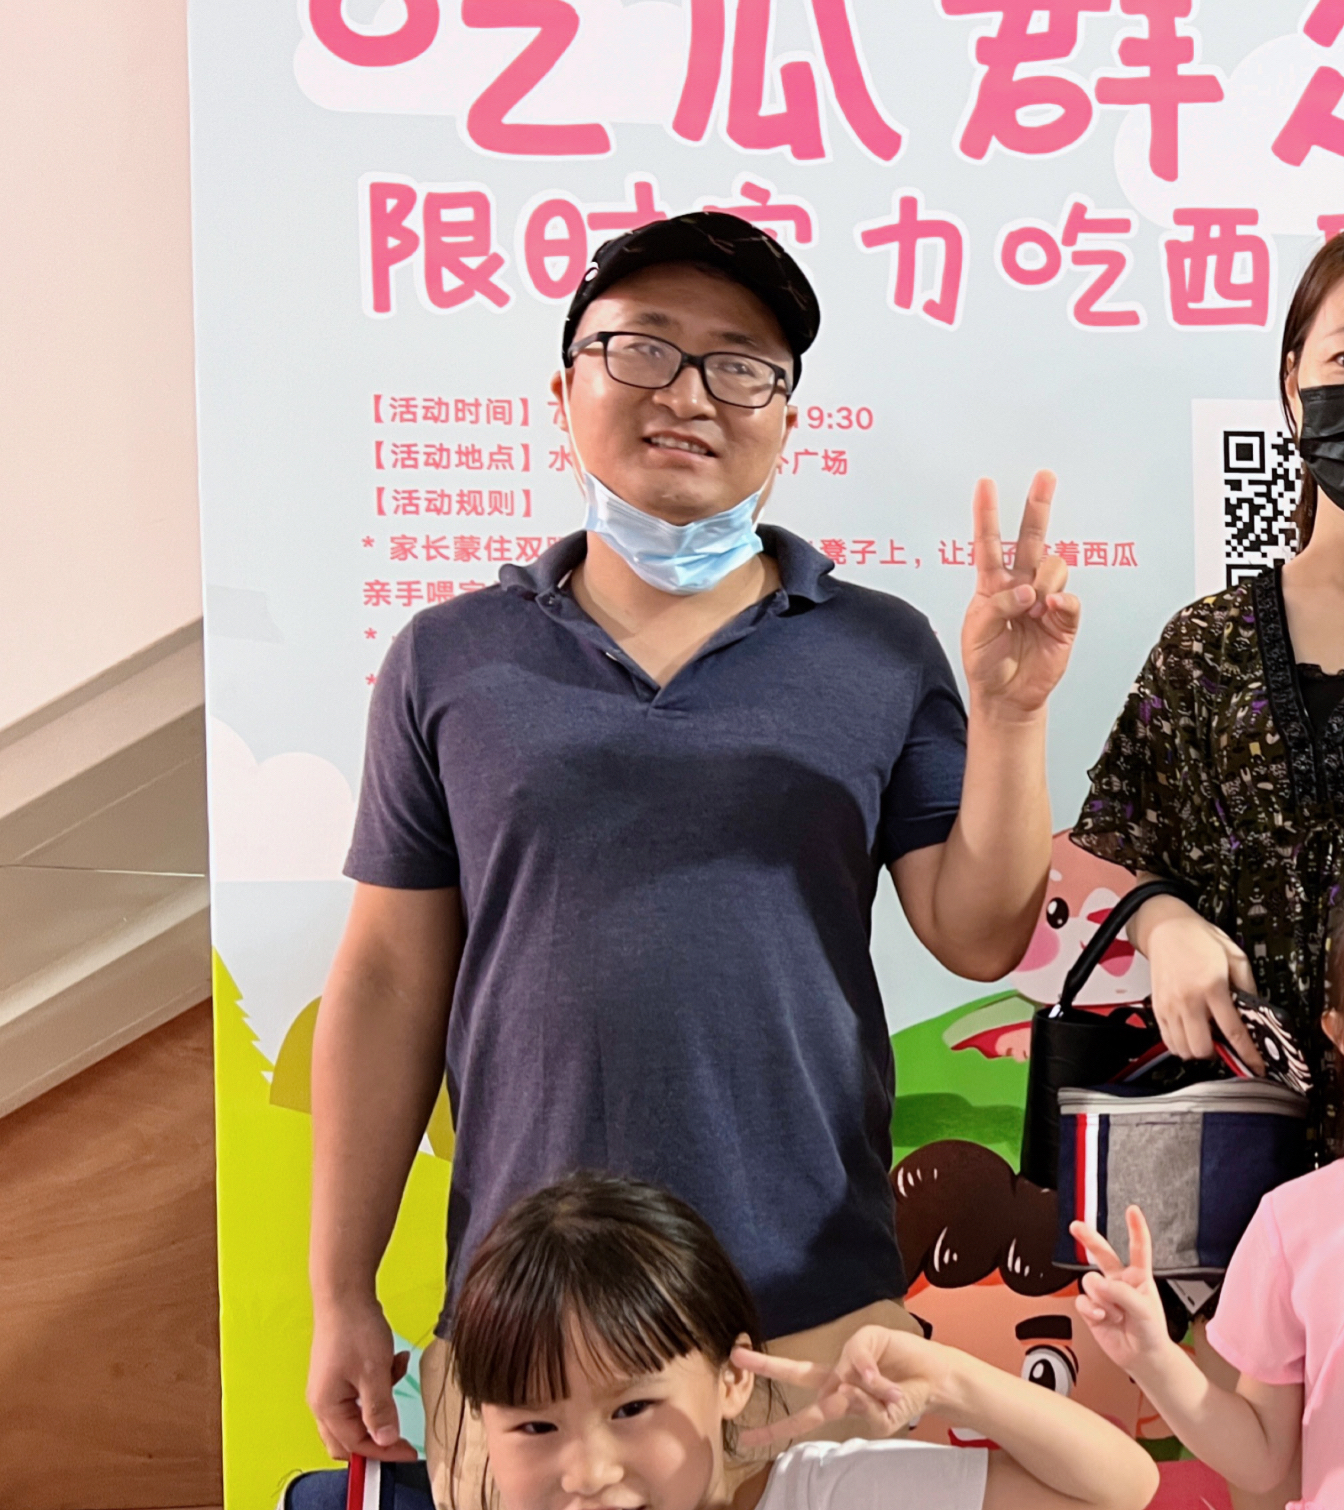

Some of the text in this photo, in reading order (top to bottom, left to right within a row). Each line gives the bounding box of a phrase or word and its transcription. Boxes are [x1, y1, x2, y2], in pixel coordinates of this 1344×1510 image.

[368, 396, 531, 428] 【活动时间】
[369, 440, 534, 472] 【活动地点】
[370, 488, 534, 518] 【活动规则】
